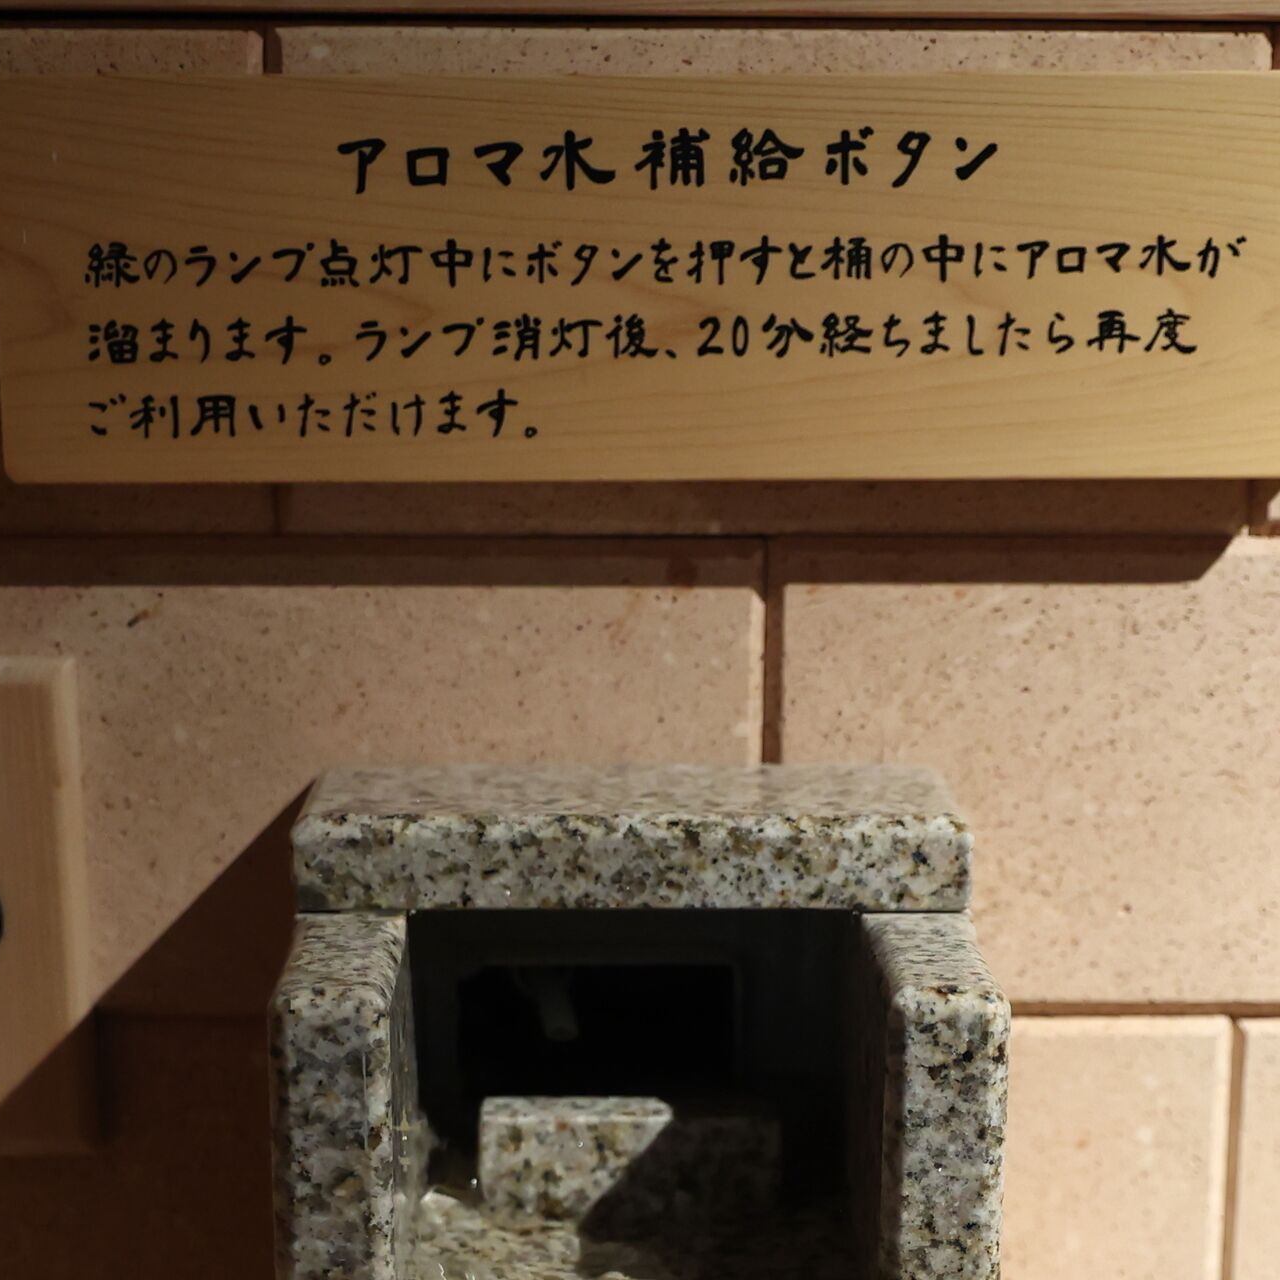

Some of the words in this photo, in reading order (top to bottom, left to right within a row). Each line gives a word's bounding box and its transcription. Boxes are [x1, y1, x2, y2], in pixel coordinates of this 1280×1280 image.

[336, 126, 998, 195] アロマ水補給ボタン
[84, 234, 1247, 288] 緑のランプ点灯中にボタンを押すと桶の中にアロマ水が
[88, 387, 538, 440] ご利用いただけます。
